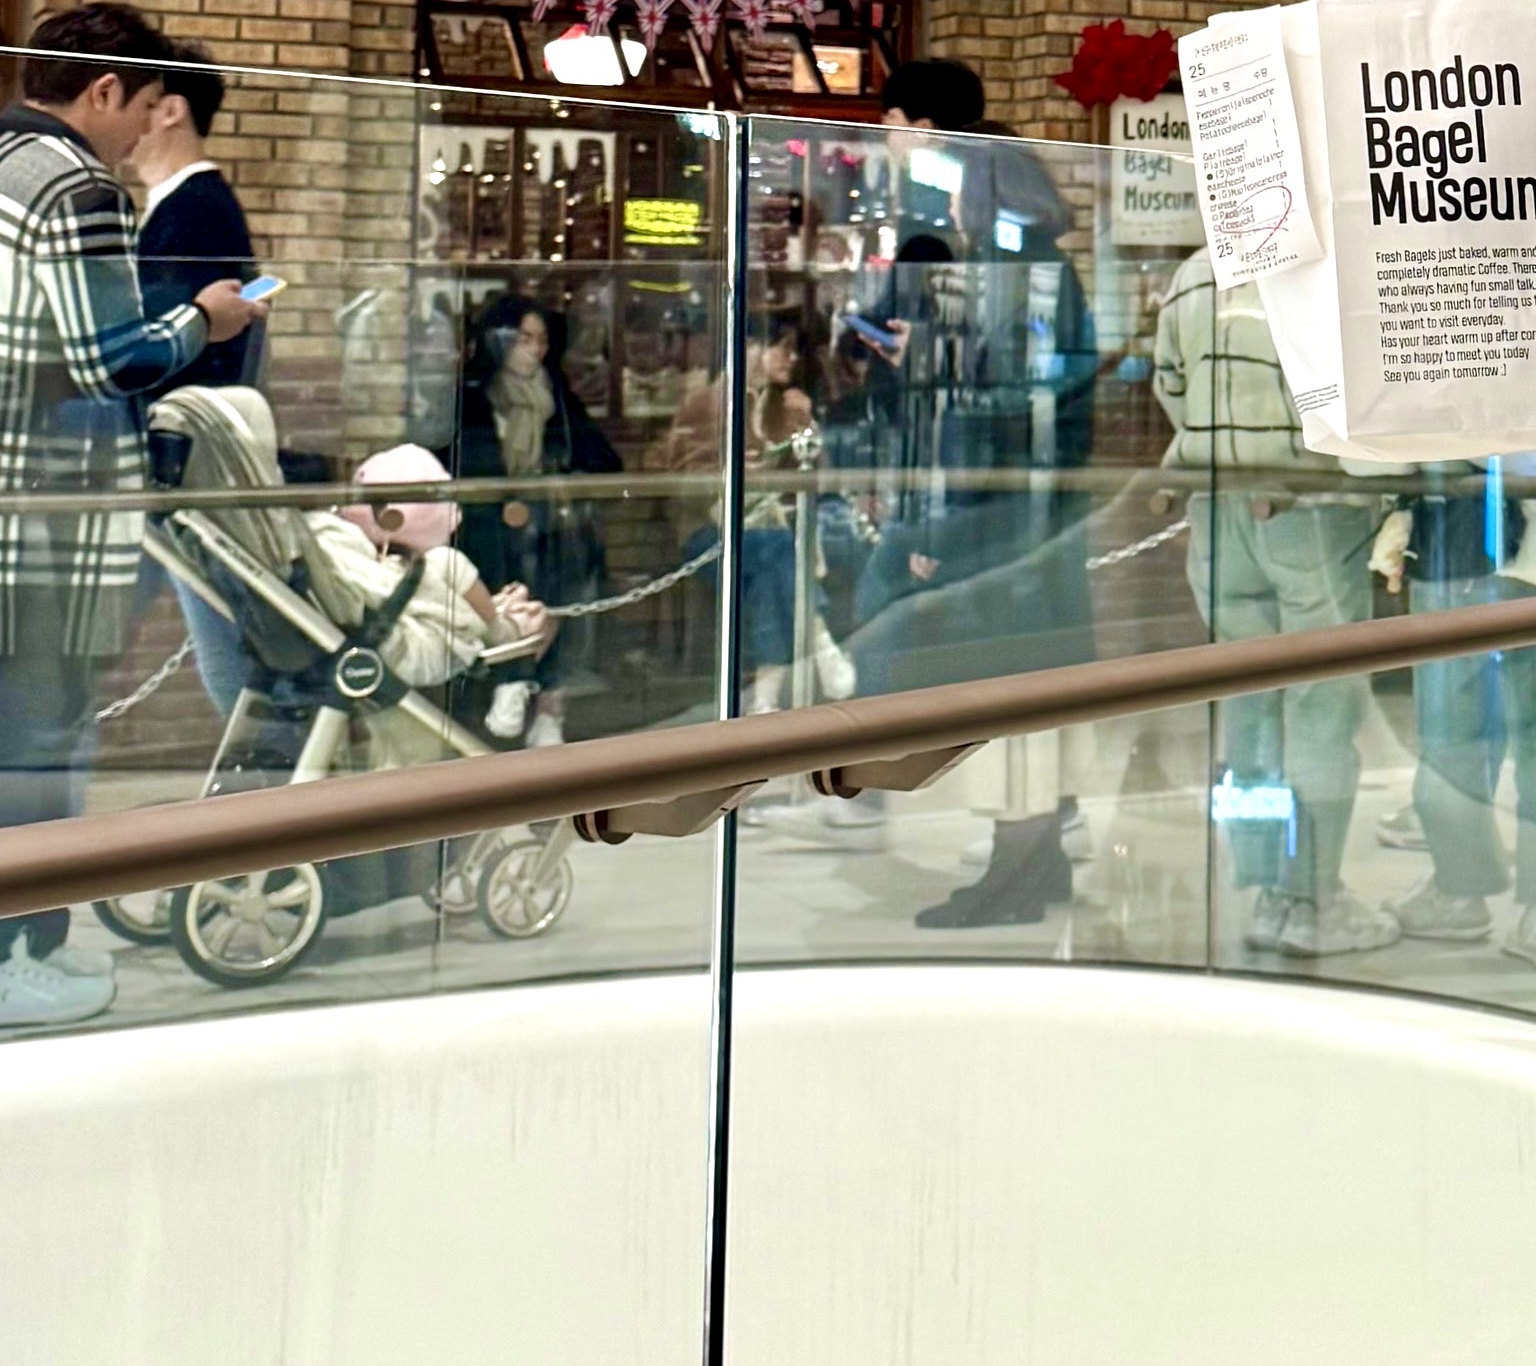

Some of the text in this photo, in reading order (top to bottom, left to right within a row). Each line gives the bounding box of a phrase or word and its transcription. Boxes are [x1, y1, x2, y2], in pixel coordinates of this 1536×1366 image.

[1189, 63, 1206, 78] 25
[1361, 55, 1522, 113] London
[1123, 111, 1190, 140] London
[1365, 109, 1487, 179] Bagel
[1124, 150, 1172, 181] Bagel
[1124, 184, 1196, 211] Museum
[1217, 242, 1233, 259] 25
[1376, 251, 1402, 263] Fresh
[1405, 249, 1436, 264] Bagels
[1438, 247, 1456, 262] just
[1492, 247, 1519, 258] warm
[1377, 266, 1430, 281] completely
[1433, 264, 1475, 277] dramatic
[1512, 262, 1536, 274] There
[1378, 285, 1399, 297] who
[1401, 283, 1434, 297] always
[1437, 281, 1468, 295] having
[1471, 280, 1486, 292] fun
[1489, 279, 1514, 291] small
[1379, 300, 1408, 314] Thank
[1410, 302, 1428, 315] you
[1430, 301, 1441, 311] so
[1444, 298, 1470, 310] much
[1473, 296, 1486, 309] for
[1489, 295, 1518, 310] telling
[1521, 297, 1532, 307] us
[1380, 321, 1398, 333] you
[1400, 318, 1425, 330] want
[1427, 317, 1437, 328] to
[1439, 315, 1459, 328] visit
[1381, 336, 1397, 348] Has
[1399, 336, 1419, 349] your
[1423, 333, 1448, 346] heart
[1451, 333, 1478, 344] warm
[1481, 332, 1493, 344] up
[1495, 329, 1518, 341] after
[1383, 346, 1529, 365] I'm so happy to meet you today
[1384, 370, 1401, 382] See
[1403, 370, 1421, 383] you
[1423, 367, 1450, 382] again
[1452, 366, 1498, 379] tomorrow
